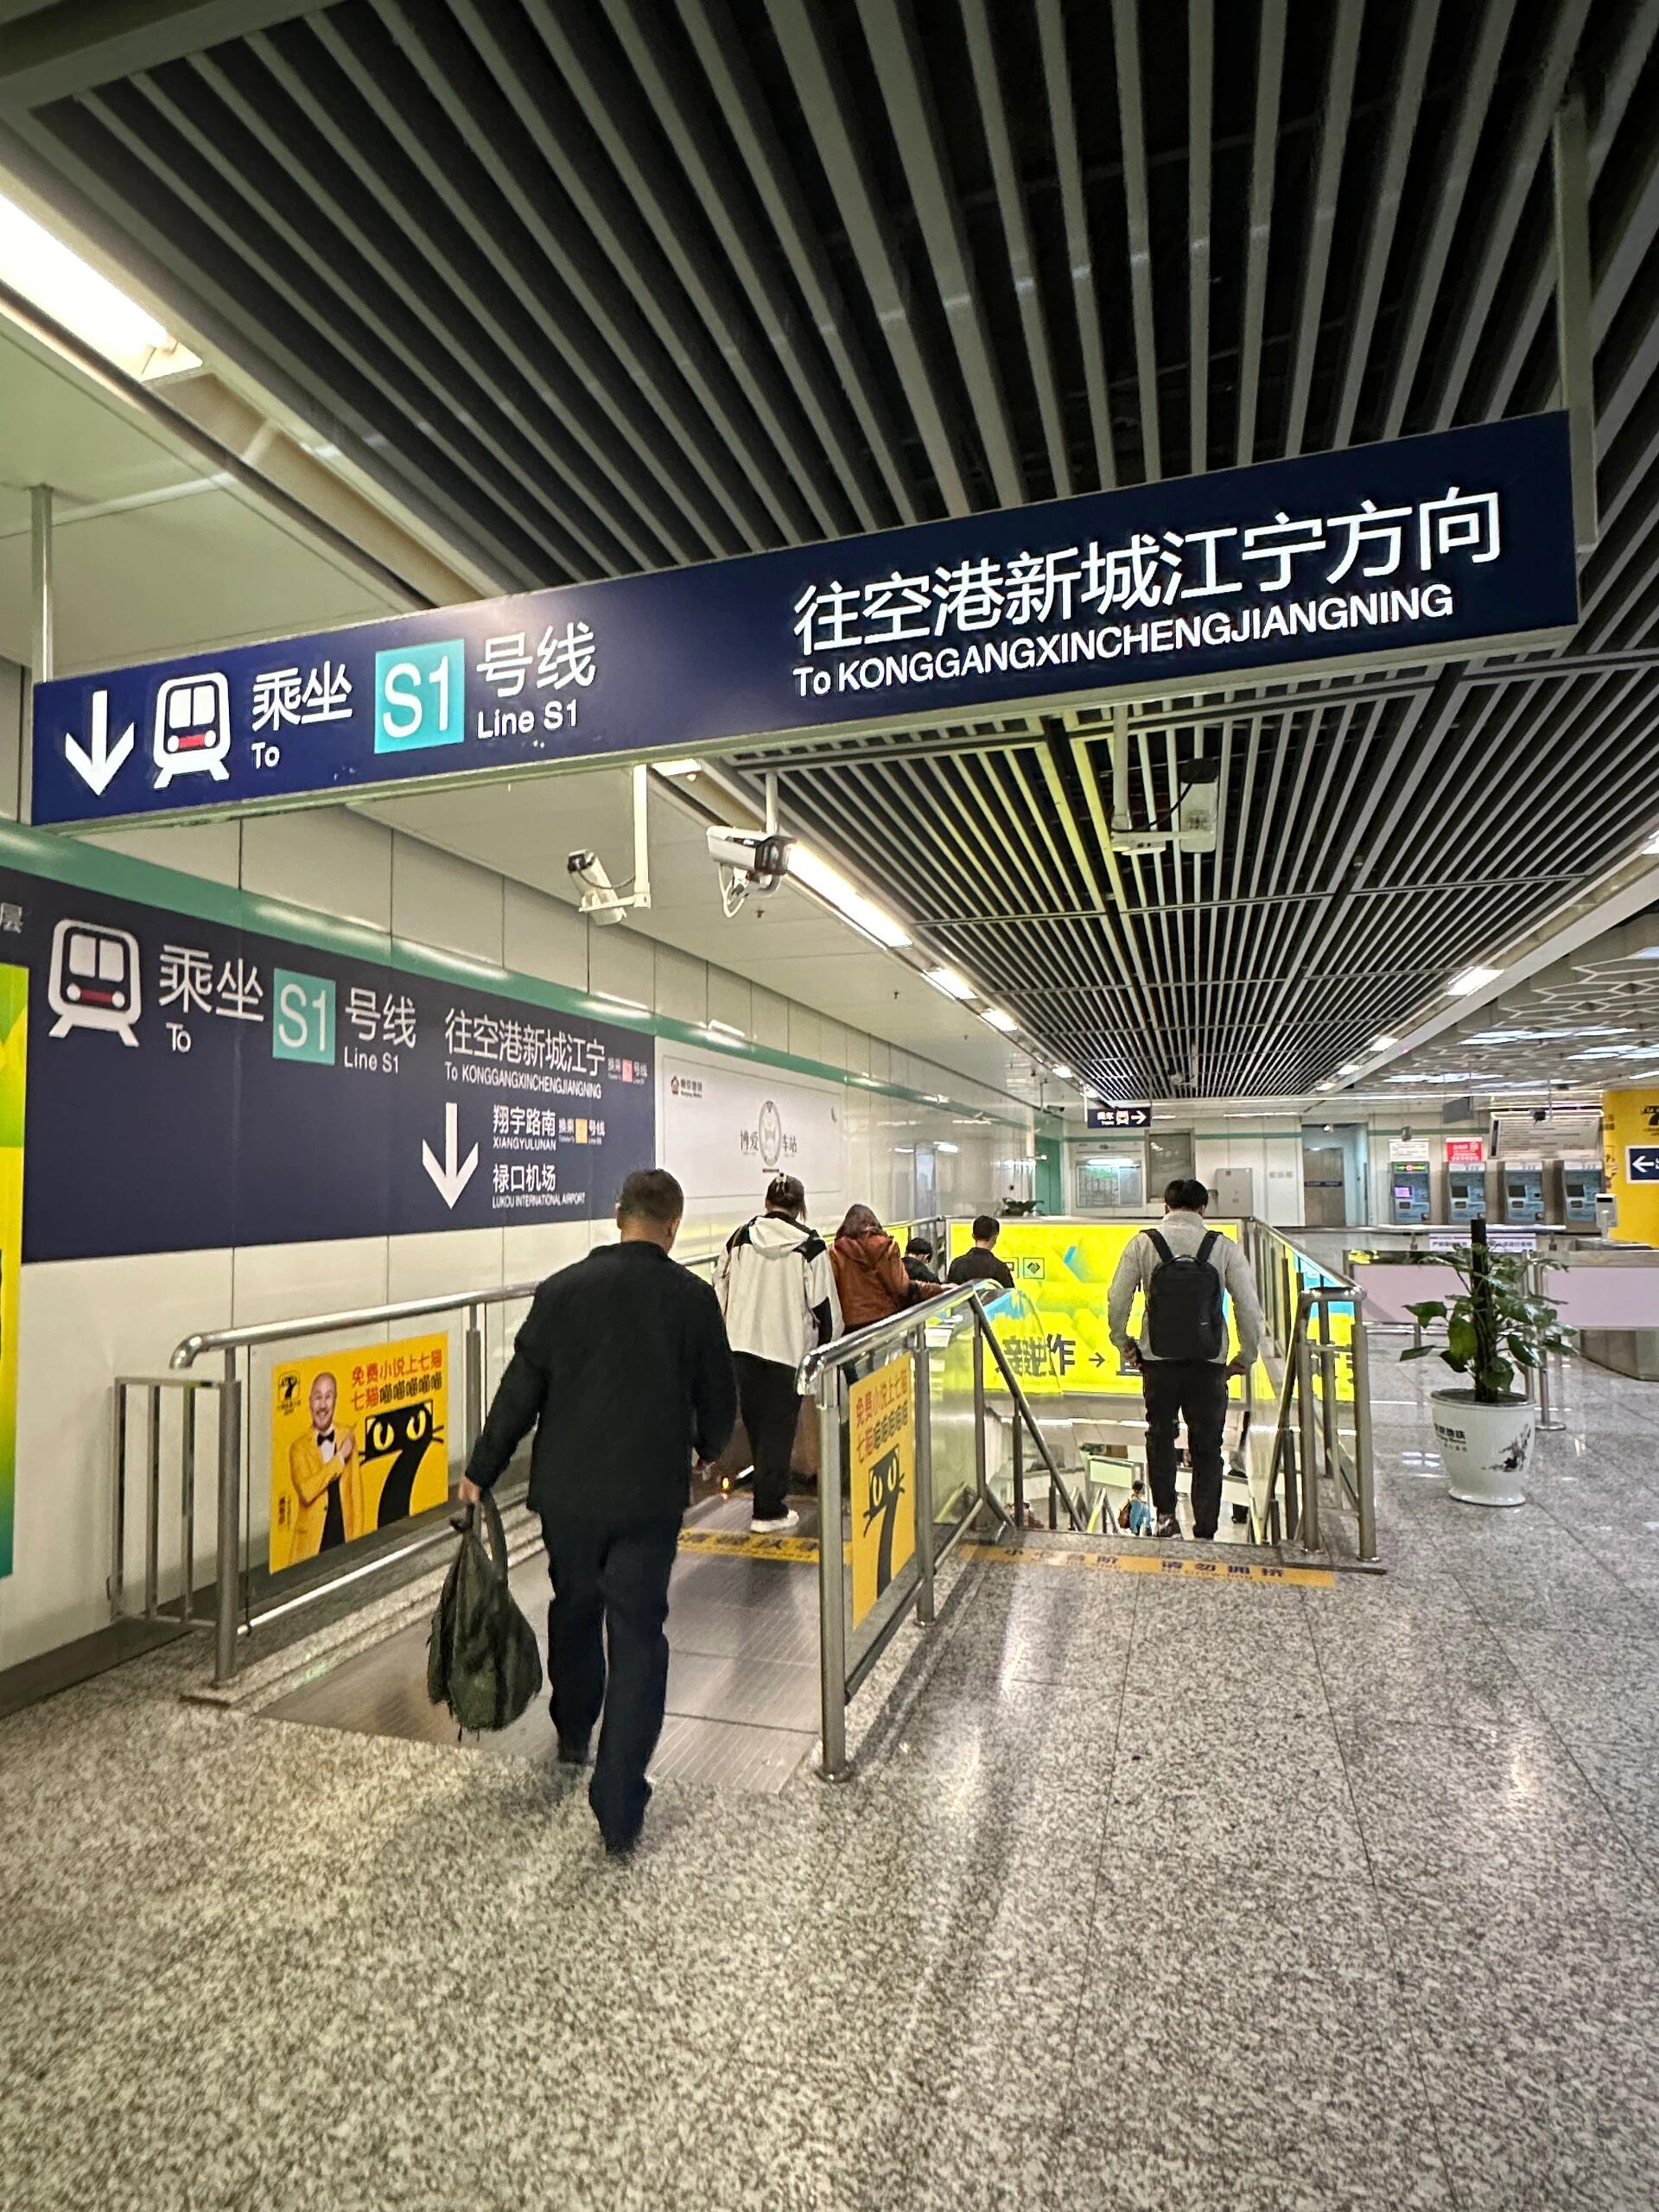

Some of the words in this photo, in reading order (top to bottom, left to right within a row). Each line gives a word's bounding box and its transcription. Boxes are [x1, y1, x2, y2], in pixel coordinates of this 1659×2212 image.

[794, 486, 1502, 658] 往空港新城江宁方向
[792, 666, 831, 696] To
[839, 582, 1454, 693] KONGGANGXINCHENGJIANGNING
[252, 659, 353, 734] 乘坐
[382, 656, 450, 739] S1
[476, 622, 596, 698] 号线
[251, 741, 281, 769] To
[477, 707, 535, 740] Line
[543, 700, 579, 731] S1
[158, 944, 264, 1022] 乘坐
[278, 983, 327, 1052] S1
[345, 987, 416, 1050] 号线
[166, 1022, 192, 1052] To
[344, 1046, 378, 1071] Line
[382, 1051, 399, 1075] S1
[445, 1007, 605, 1077] 往空港新城江宁
[445, 1061, 458, 1080] To
[462, 1064, 601, 1099] KONGGANGXINCHENGJIANGNING
[493, 1103, 556, 1137] 翔宇路南
[493, 1136, 556, 1151] XIANGYULUNAN
[492, 1195, 515, 1209] LUKOU
[516, 1193, 561, 1207] INTERNATIONAL
[563, 1192, 586, 1205] AIRPORT
[493, 1163, 556, 1193] 禄口机场
